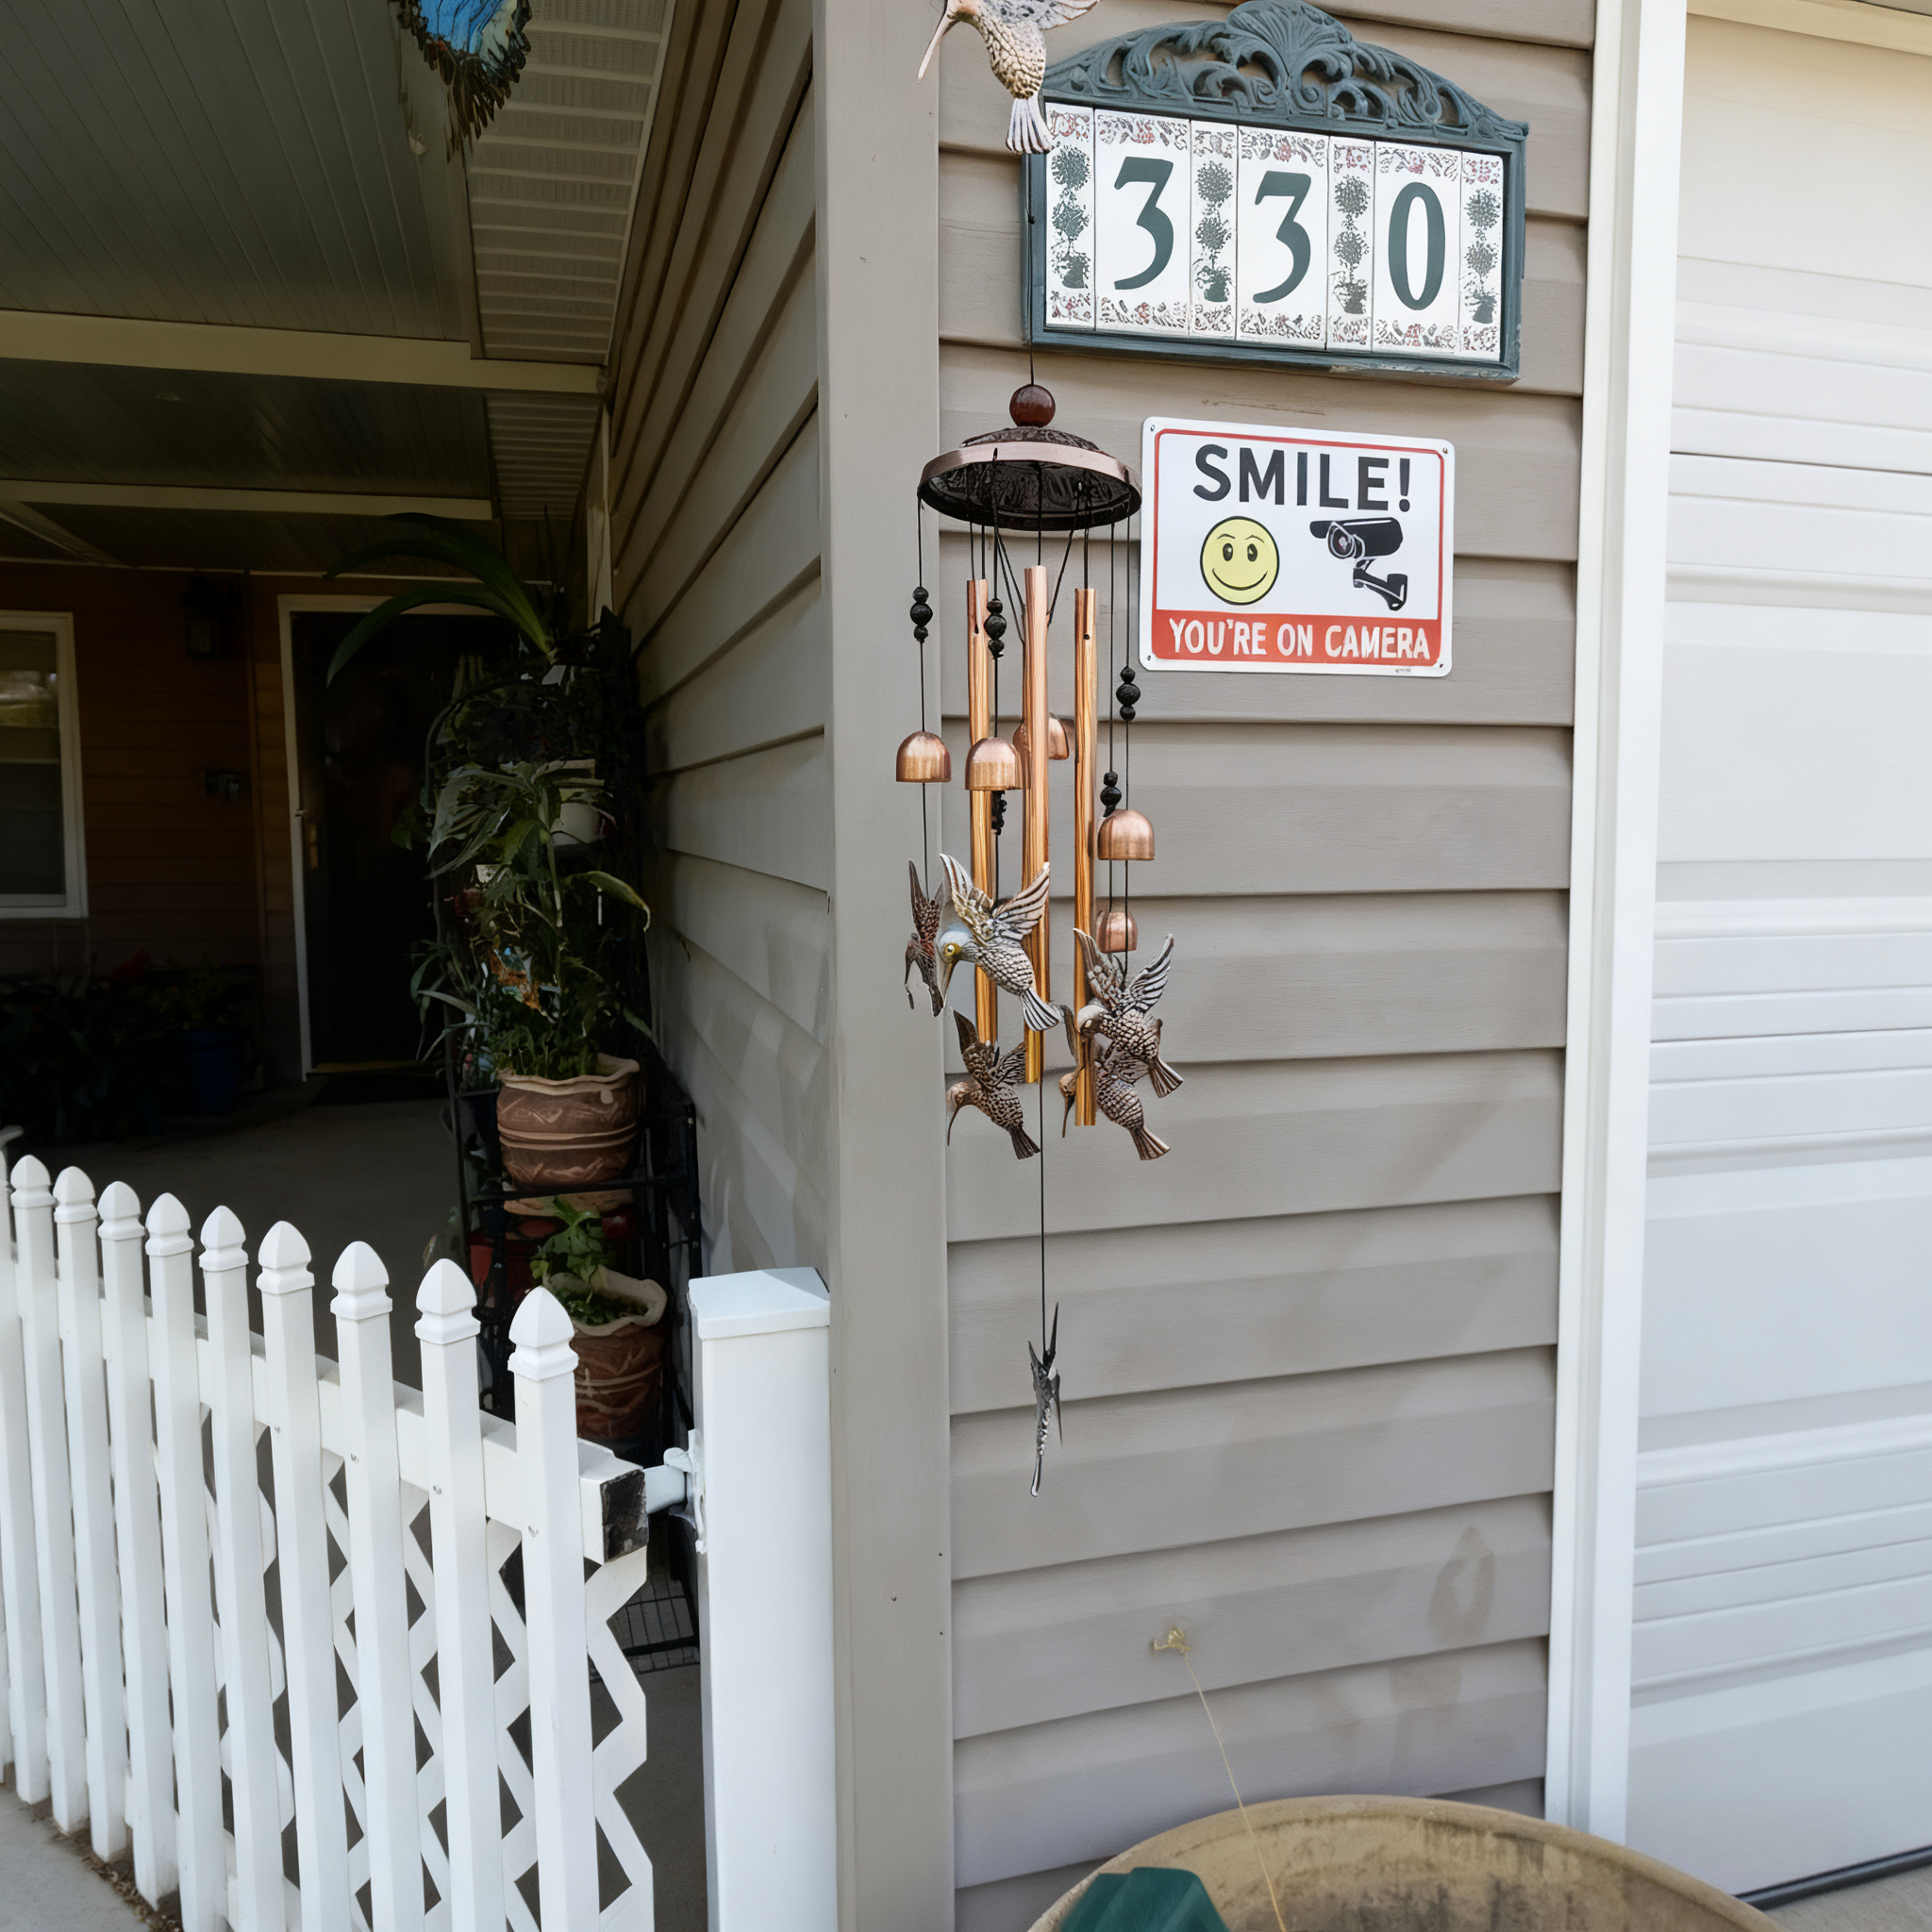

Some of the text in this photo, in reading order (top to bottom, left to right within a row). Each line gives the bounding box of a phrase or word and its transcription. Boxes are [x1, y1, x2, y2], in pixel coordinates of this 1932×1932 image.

[1113, 156, 1446, 311] 330
[1192, 443, 1411, 513] SMILE!
[1169, 618, 1431, 660] YOU'RE ON CAMERA
